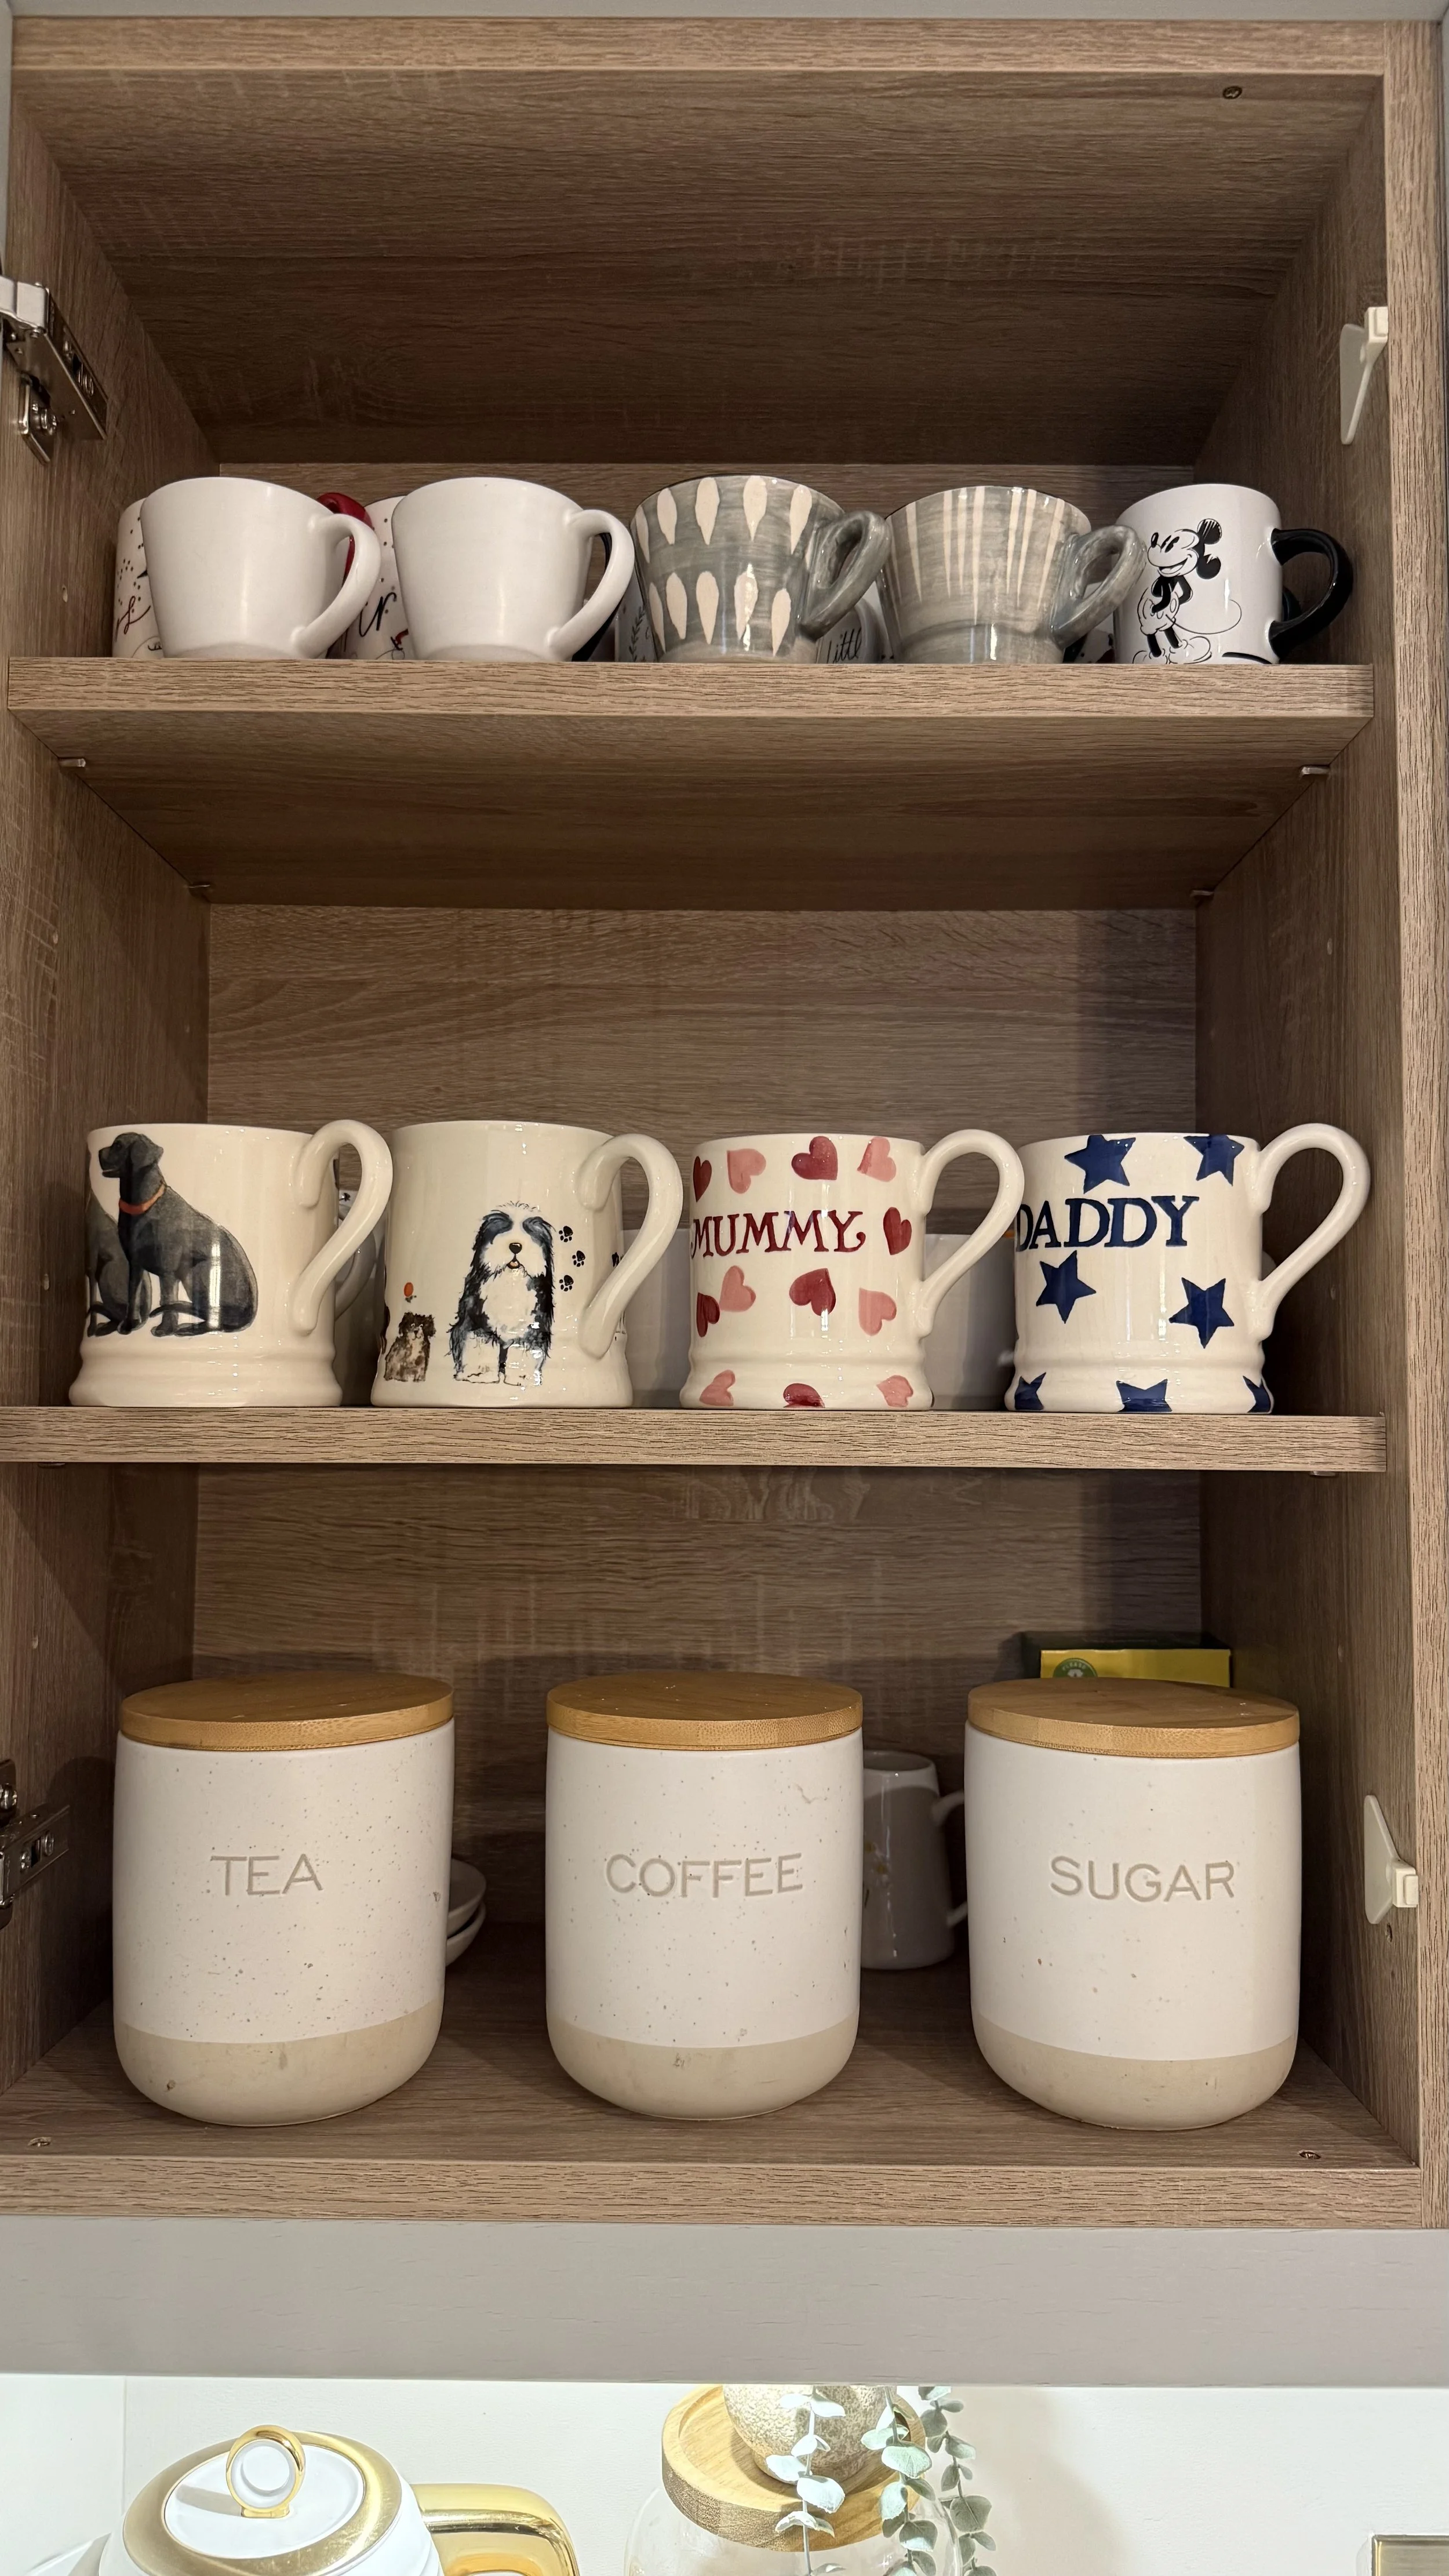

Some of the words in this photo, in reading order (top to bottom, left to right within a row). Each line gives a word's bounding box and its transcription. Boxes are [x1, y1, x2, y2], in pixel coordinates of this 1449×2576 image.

[690, 1210, 867, 1259] MUMMY
[1015, 1195, 1200, 1252] DADDY
[210, 1854, 323, 1896] TEA
[606, 1853, 803, 1898] COFFEE
[1050, 1855, 1235, 1903] SUGAR
